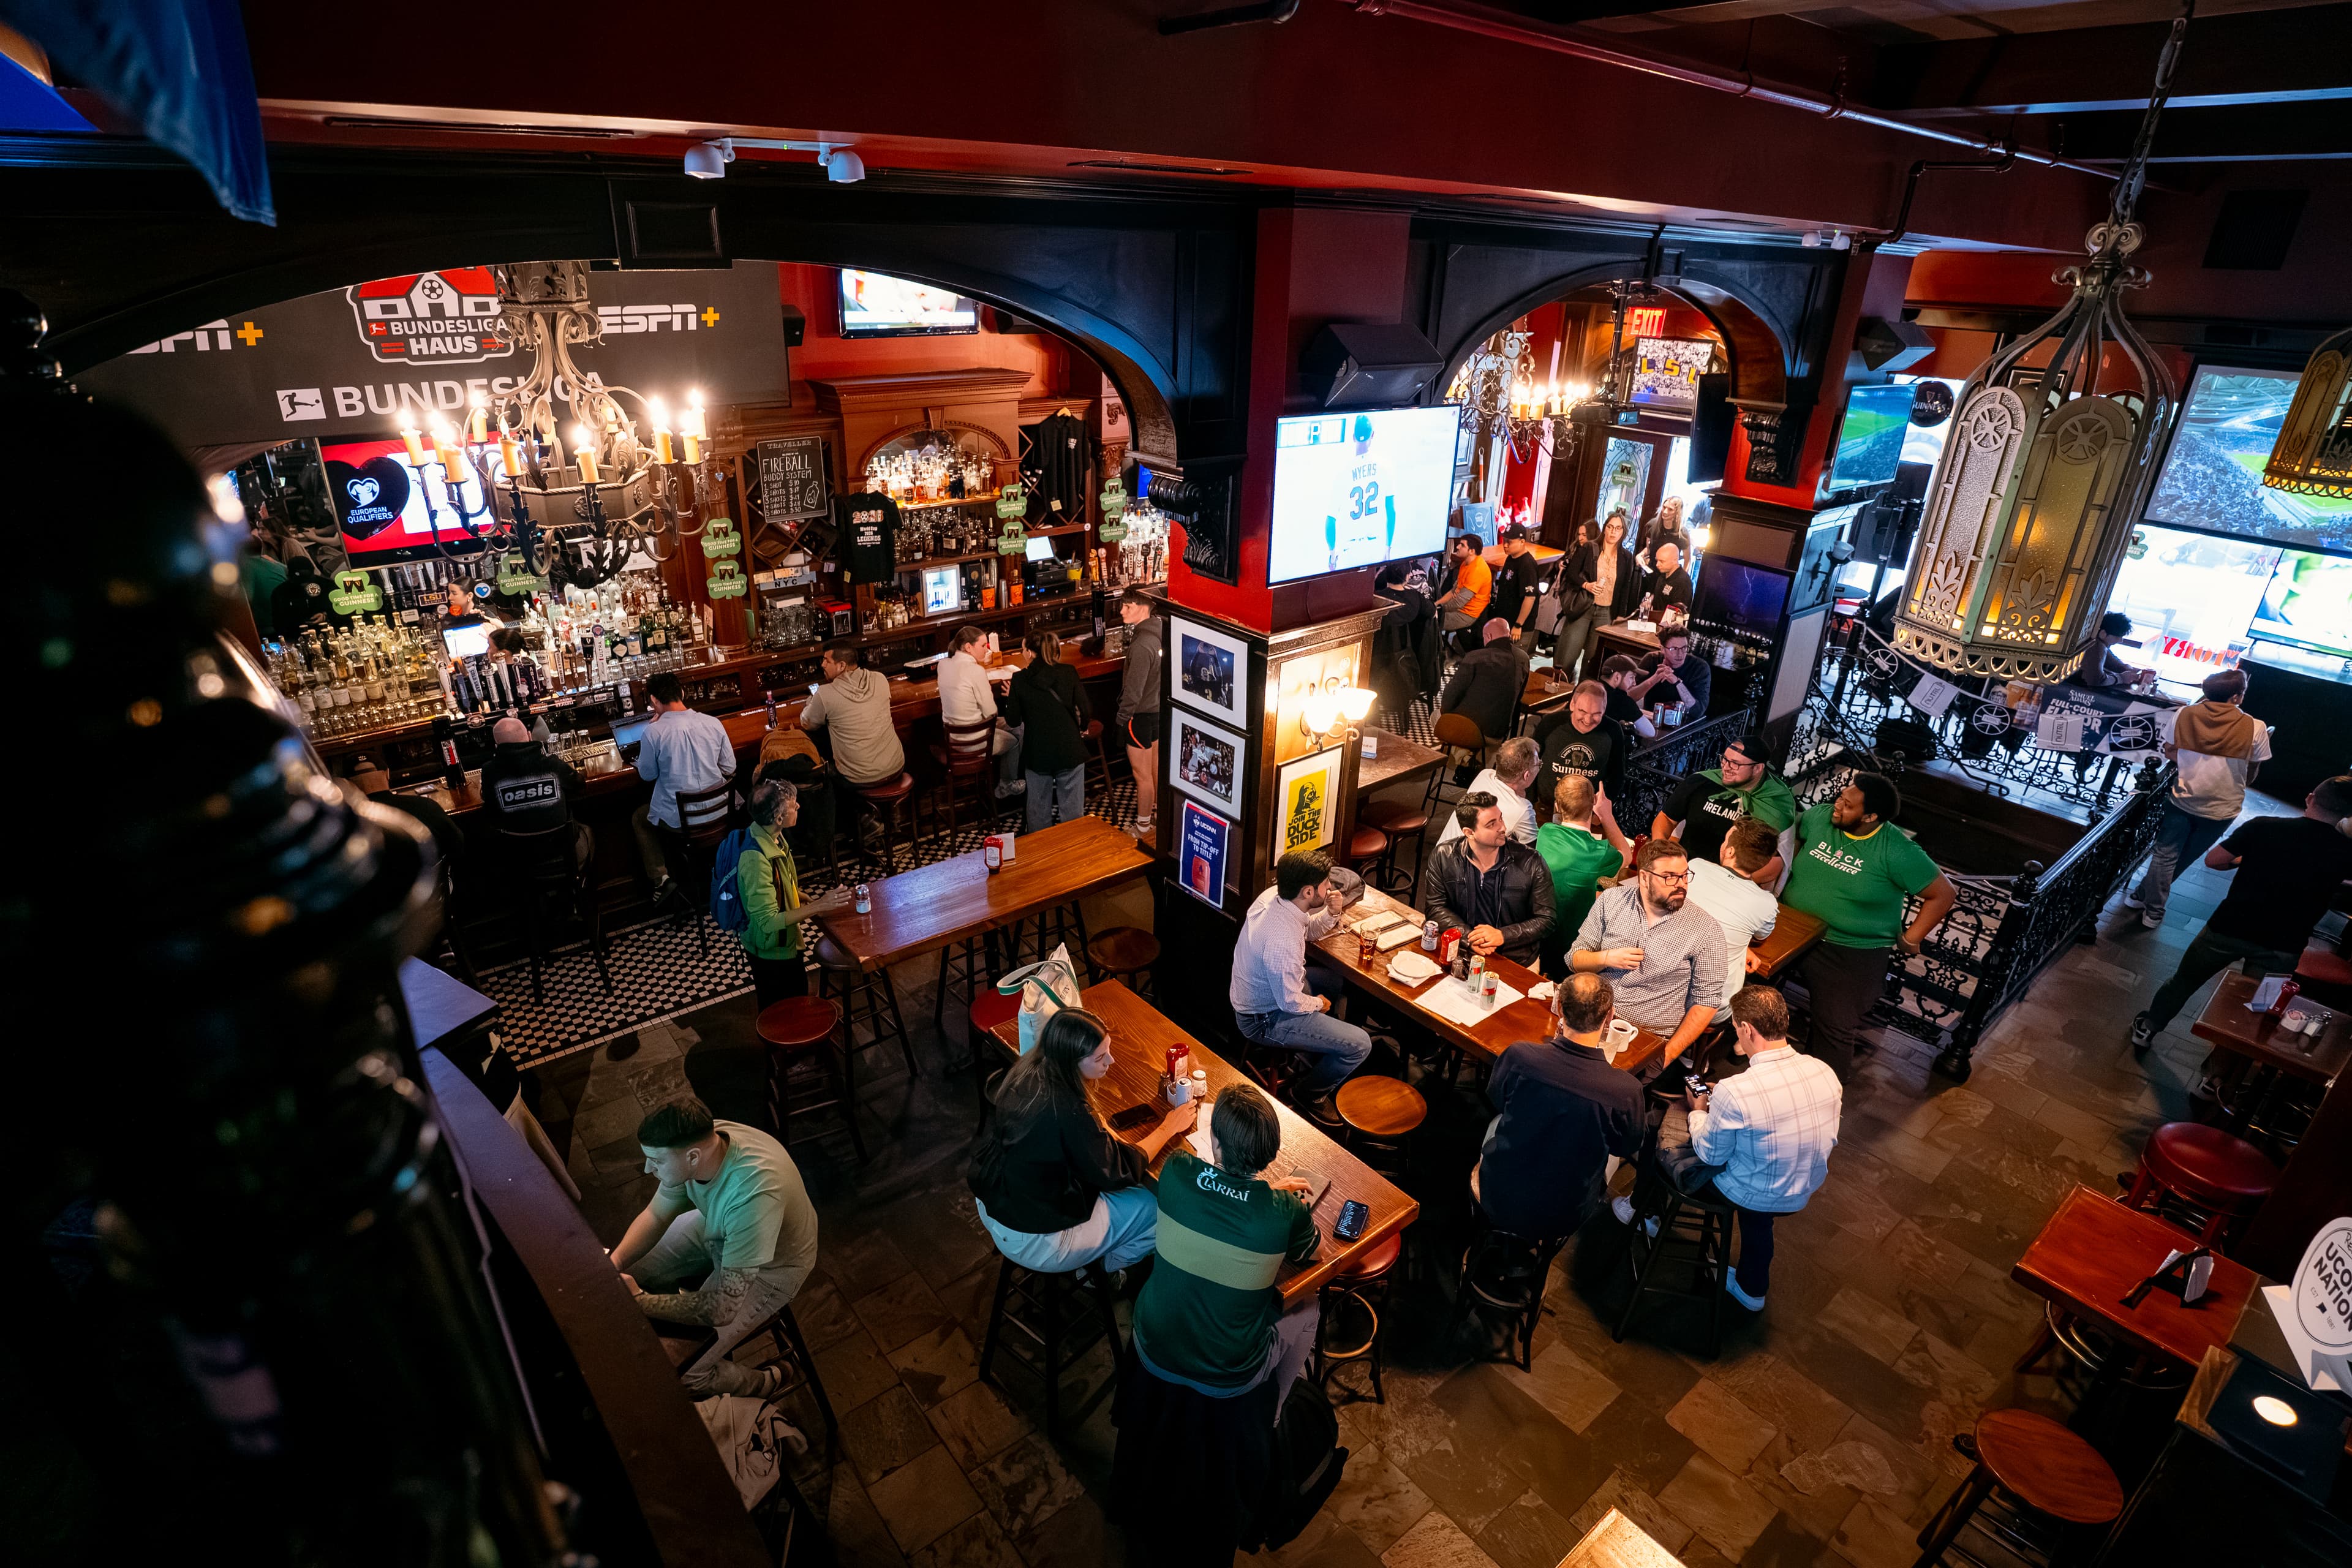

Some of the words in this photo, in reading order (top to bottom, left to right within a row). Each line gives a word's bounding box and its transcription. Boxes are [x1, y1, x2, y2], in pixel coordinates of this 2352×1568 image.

[390, 318, 507, 335] BUNDESLIGA
[1630, 309, 1663, 336] EXIT
[409, 336, 477, 355] HAUS
[1913, 401, 1946, 412] UINNESS
[763, 454, 812, 473] FIREBALL
[1352, 463, 1378, 481] MYERS
[764, 472, 785, 482] BUDDY
[786, 470, 812, 479] SYSTEM
[1349, 481, 1379, 520] 32
[348, 512, 394, 524] QUALIFIERS
[350, 507, 388, 516] EUROPEAN
[505, 579, 537, 588] GUINNESS
[774, 579, 797, 588] NYC
[339, 597, 375, 606] GUINNESS
[2068, 690, 2095, 702] SAMUEL
[2068, 696, 2091, 706] ADAMS
[2050, 698, 2105, 717] FULL-COURT
[1552, 762, 1599, 777] Guinness
[505, 784, 552, 802] oasis
[1288, 814, 1306, 826] JOIN
[1308, 809, 1321, 819] THE
[1703, 801, 1741, 821] IRELAND
[1200, 821, 1216, 834] UCONN
[1287, 815, 1320, 839] DUCK
[1188, 834, 1200, 846] FROM
[1200, 841, 1219, 856] TIP-OFF
[1286, 826, 1319, 850] SIDE
[1193, 843, 1199, 852] TO
[1200, 847, 1212, 860] TITLE
[1818, 842, 1864, 867] BLACK
[1809, 850, 1858, 875] excellence
